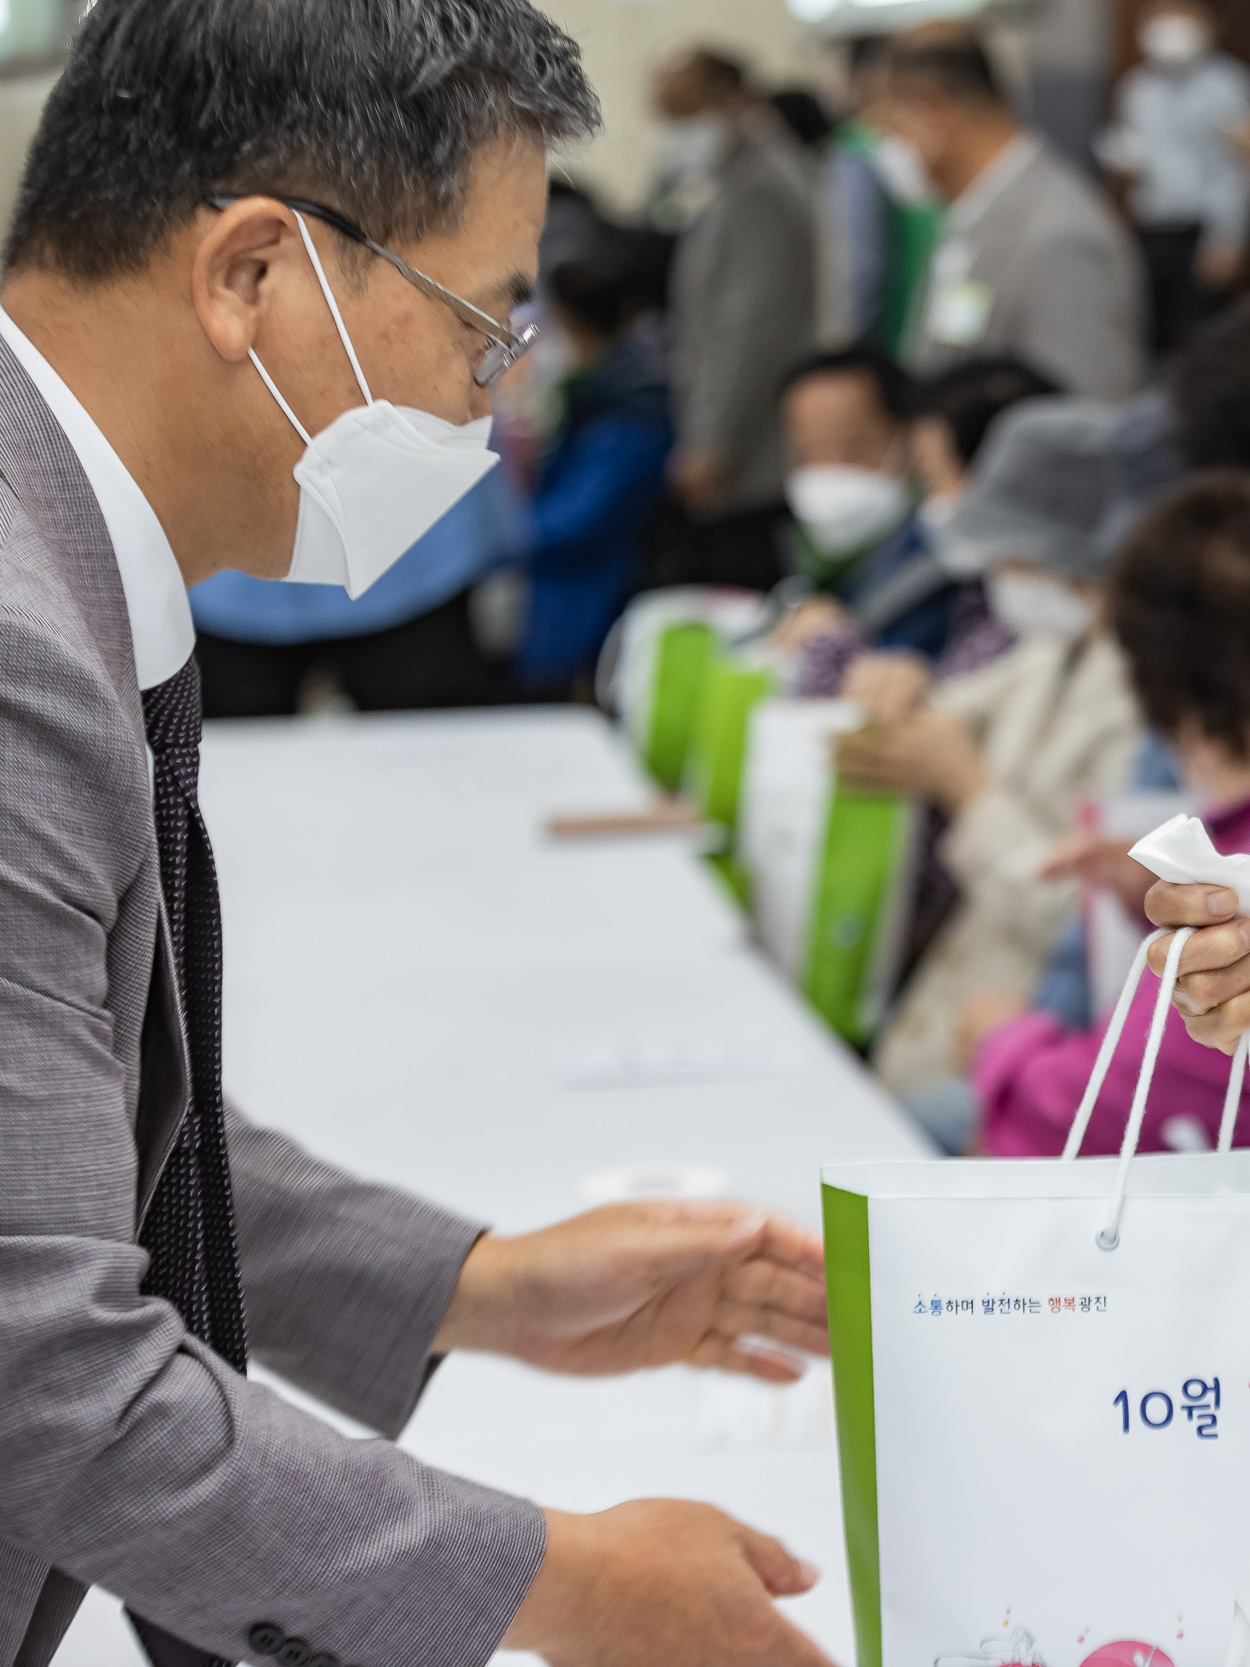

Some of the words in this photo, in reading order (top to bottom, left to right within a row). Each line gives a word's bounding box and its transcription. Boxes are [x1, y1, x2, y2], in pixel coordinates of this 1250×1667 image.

[913, 1294, 974, 1317] 소통하며
[981, 1292, 1042, 1316] 발전하는
[1047, 1296, 1108, 1315] 행복광진
[1112, 1376, 1223, 1441] 10월
